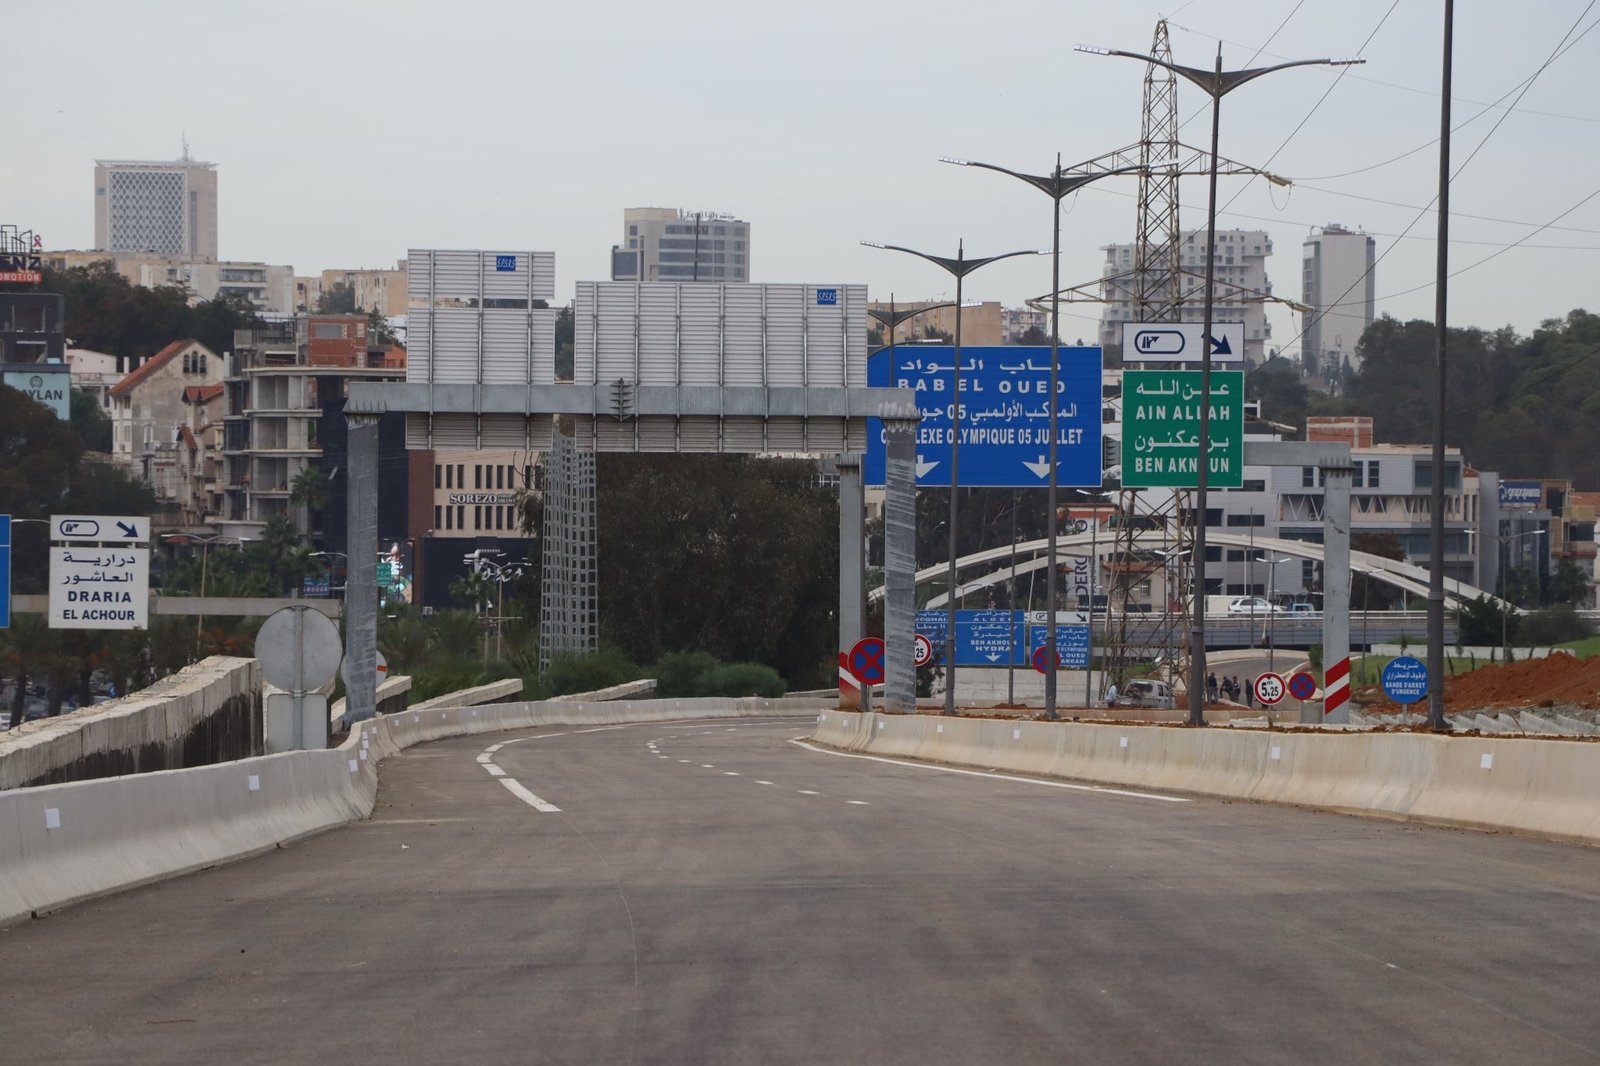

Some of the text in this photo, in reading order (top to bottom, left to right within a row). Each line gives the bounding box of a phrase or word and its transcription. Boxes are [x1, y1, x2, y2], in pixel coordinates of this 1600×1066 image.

[897, 378, 1066, 394] BAB EL OUED
[1136, 379, 1180, 396] الله
[946, 404, 967, 420] 05
[1135, 405, 1167, 420] AIN
[946, 428, 1015, 446] OYMPIQUE
[1018, 428, 1032, 445] 05
[1134, 429, 1200, 453] عكنون
[1135, 457, 1230, 473] BEN AKNUN
[450, 494, 498, 504] SOREZO
[63, 551, 136, 567] درارية
[62, 571, 134, 585] العاشور
[67, 590, 132, 603] DRARIA
[63, 609, 136, 621] EL ACHOUR
[1261, 682, 1279, 697] 5.25
